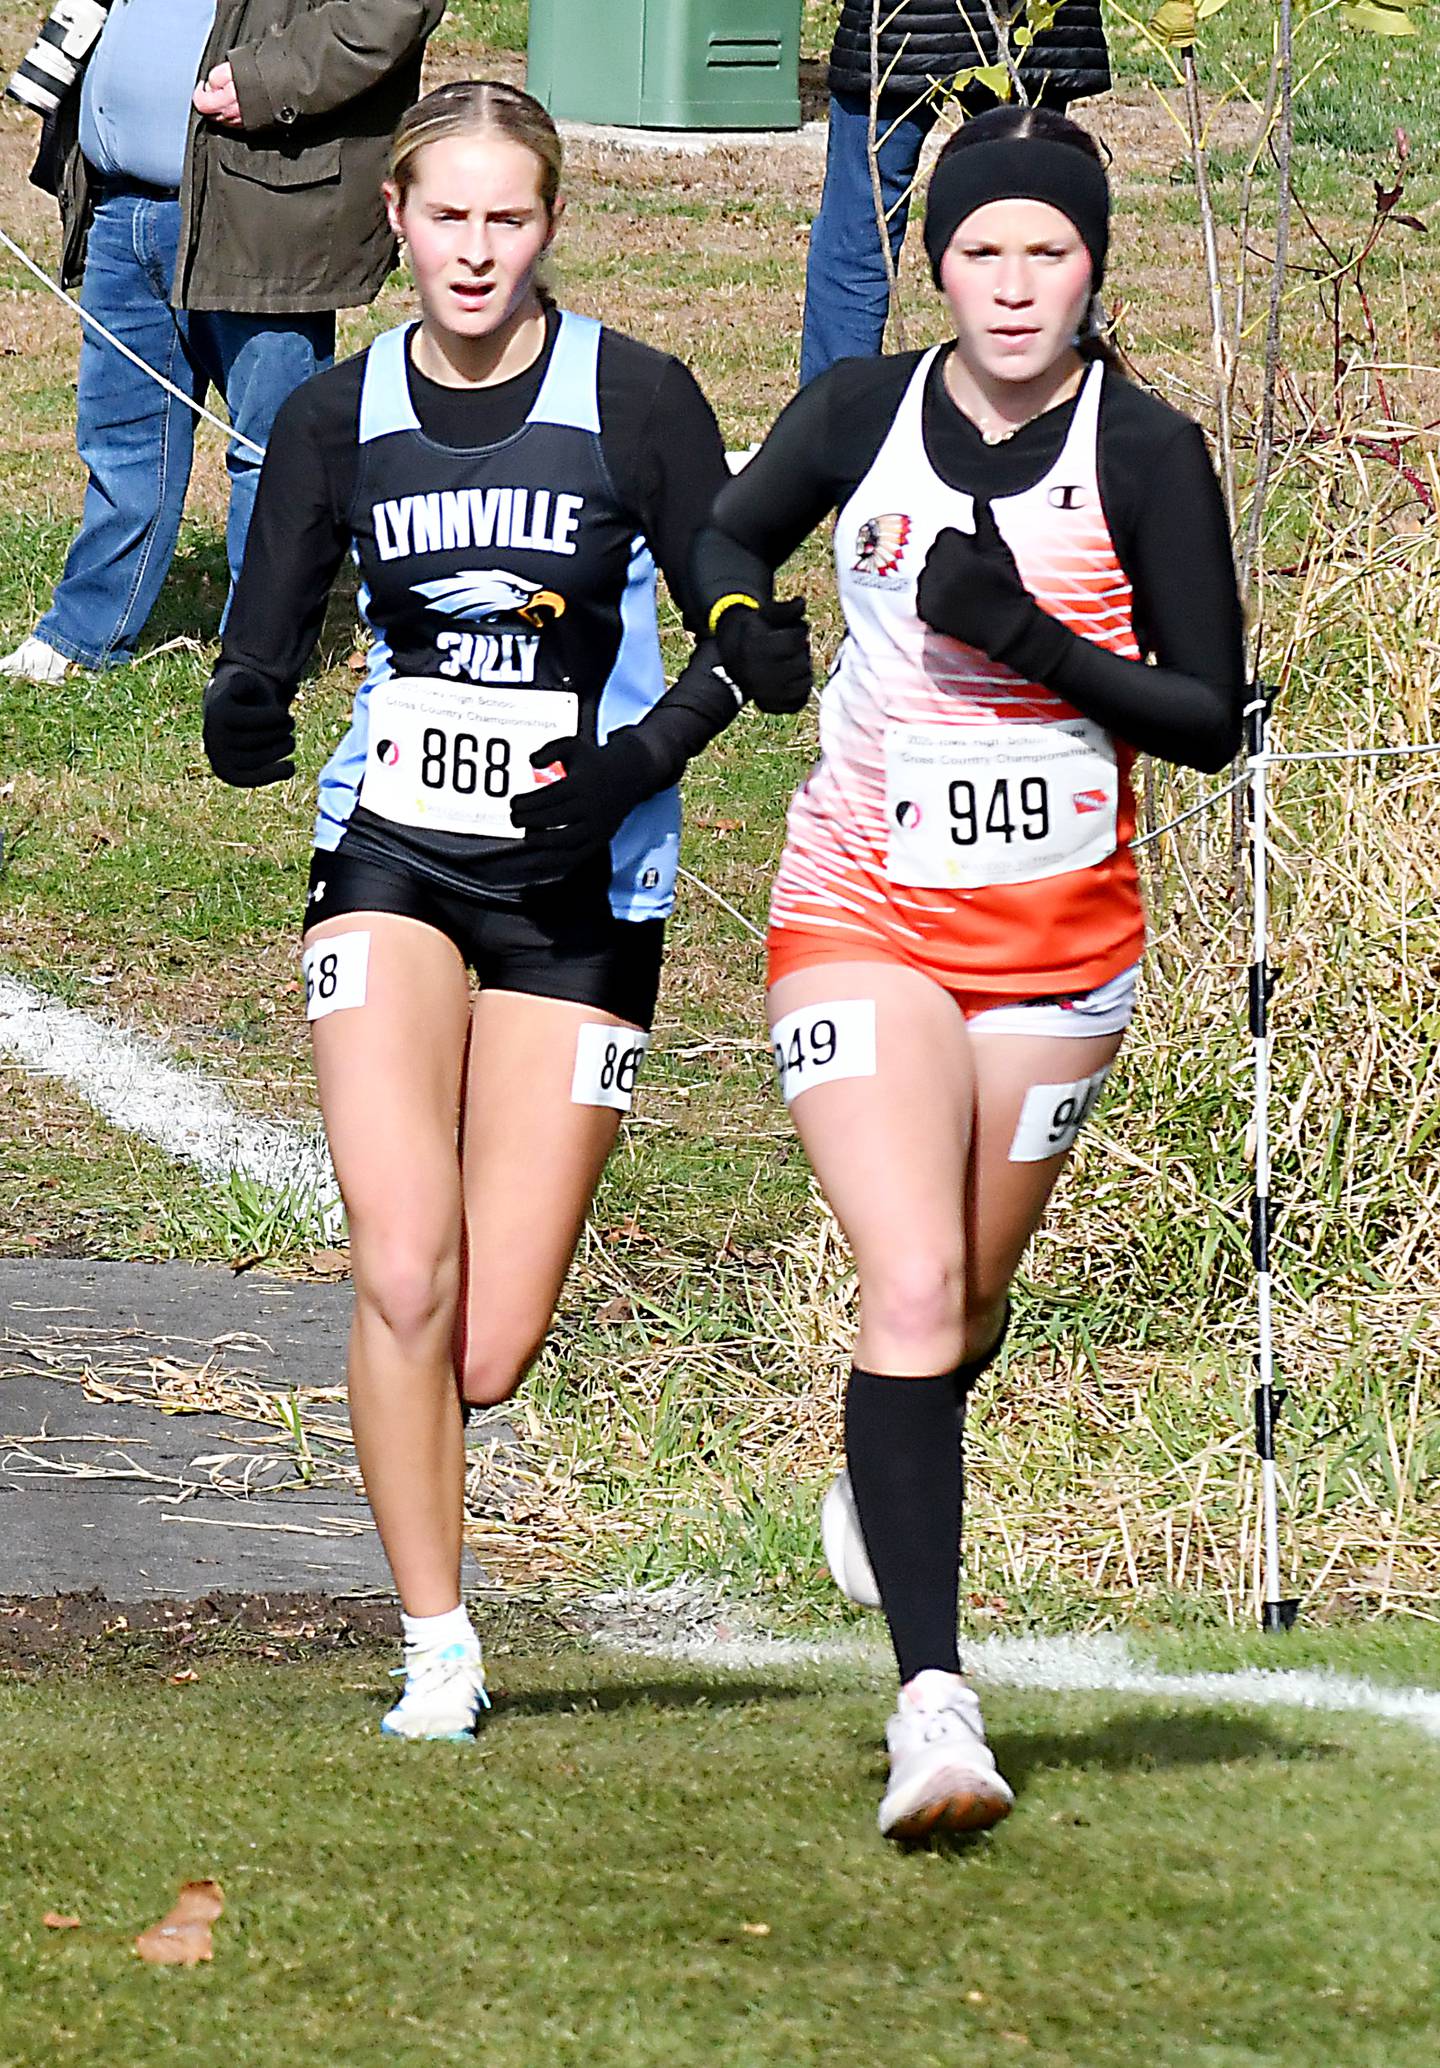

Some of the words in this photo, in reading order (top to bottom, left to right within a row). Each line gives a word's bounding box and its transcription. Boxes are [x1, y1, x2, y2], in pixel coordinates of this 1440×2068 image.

[372, 488, 584, 561] LYNNVILLE
[421, 727, 511, 798] 868
[948, 776, 1050, 846] 949
